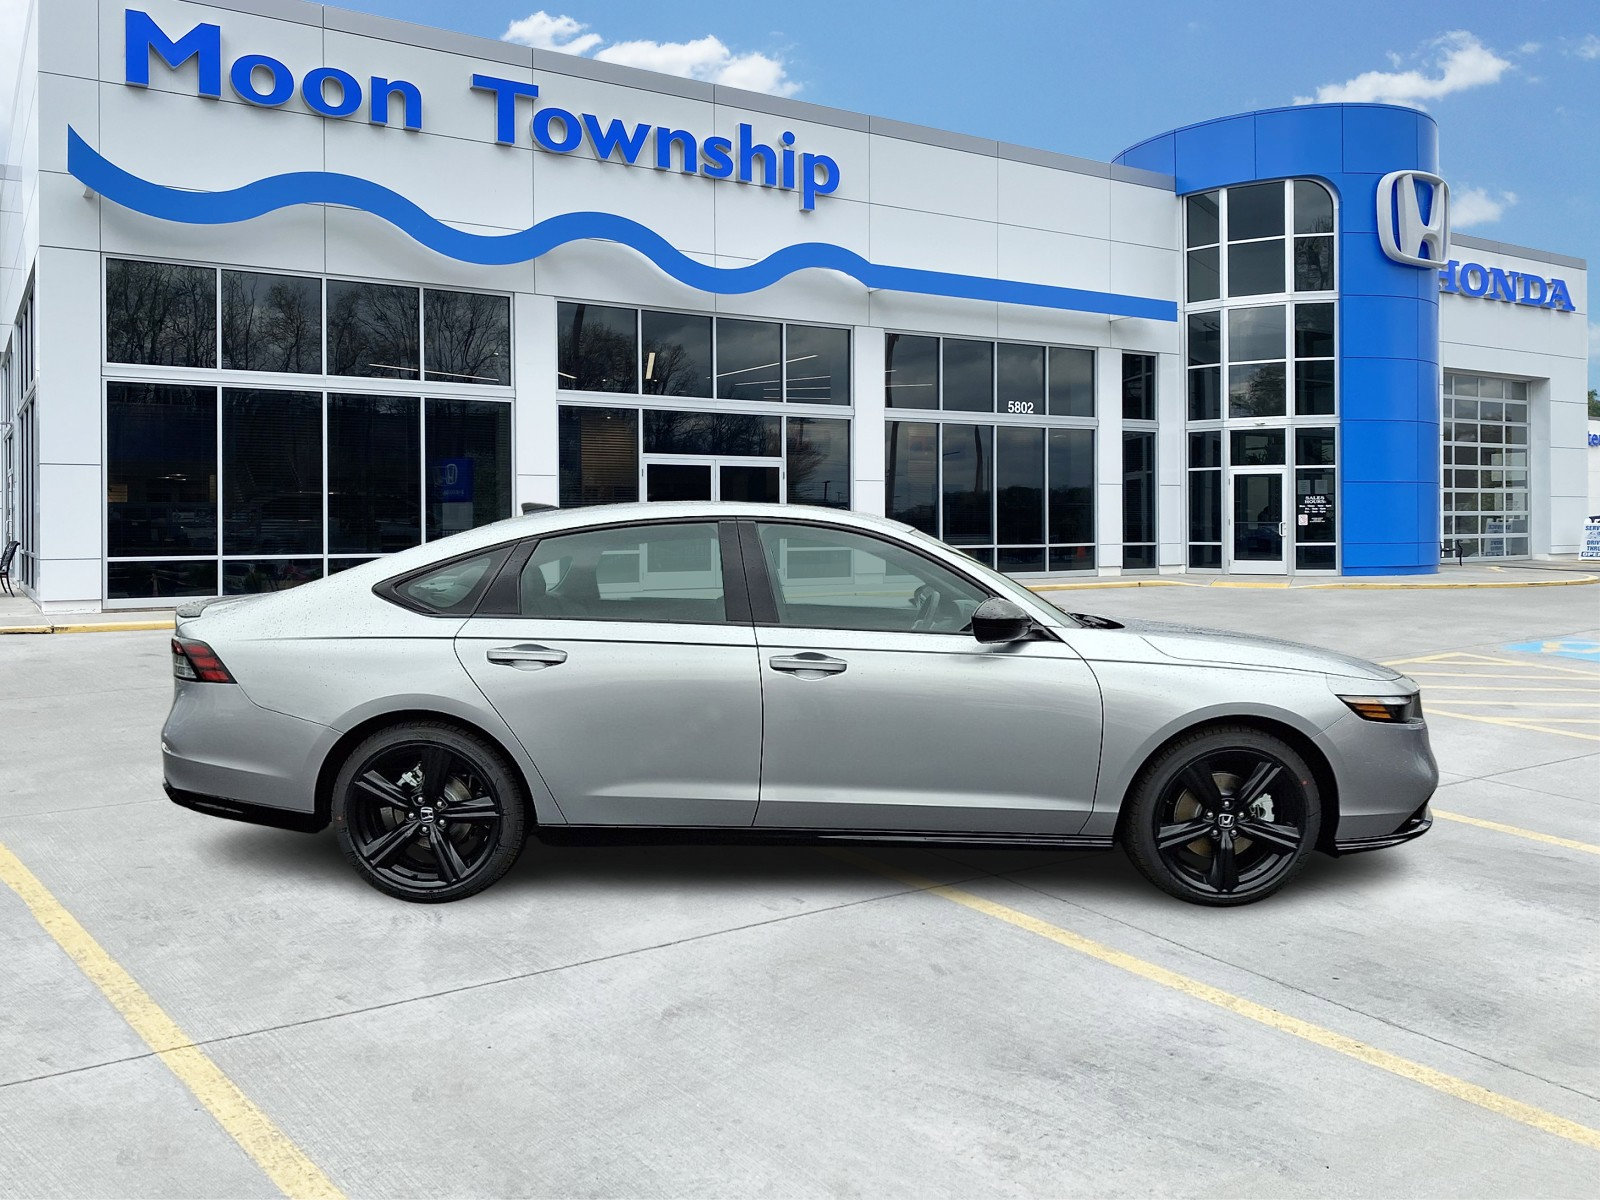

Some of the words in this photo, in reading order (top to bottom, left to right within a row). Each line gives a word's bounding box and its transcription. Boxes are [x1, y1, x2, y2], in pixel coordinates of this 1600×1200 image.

[125, 8, 422, 131] Moon
[469, 73, 840, 213] Township
[1438, 259, 1576, 312] HONDA
[1007, 400, 1034, 414] 5802
